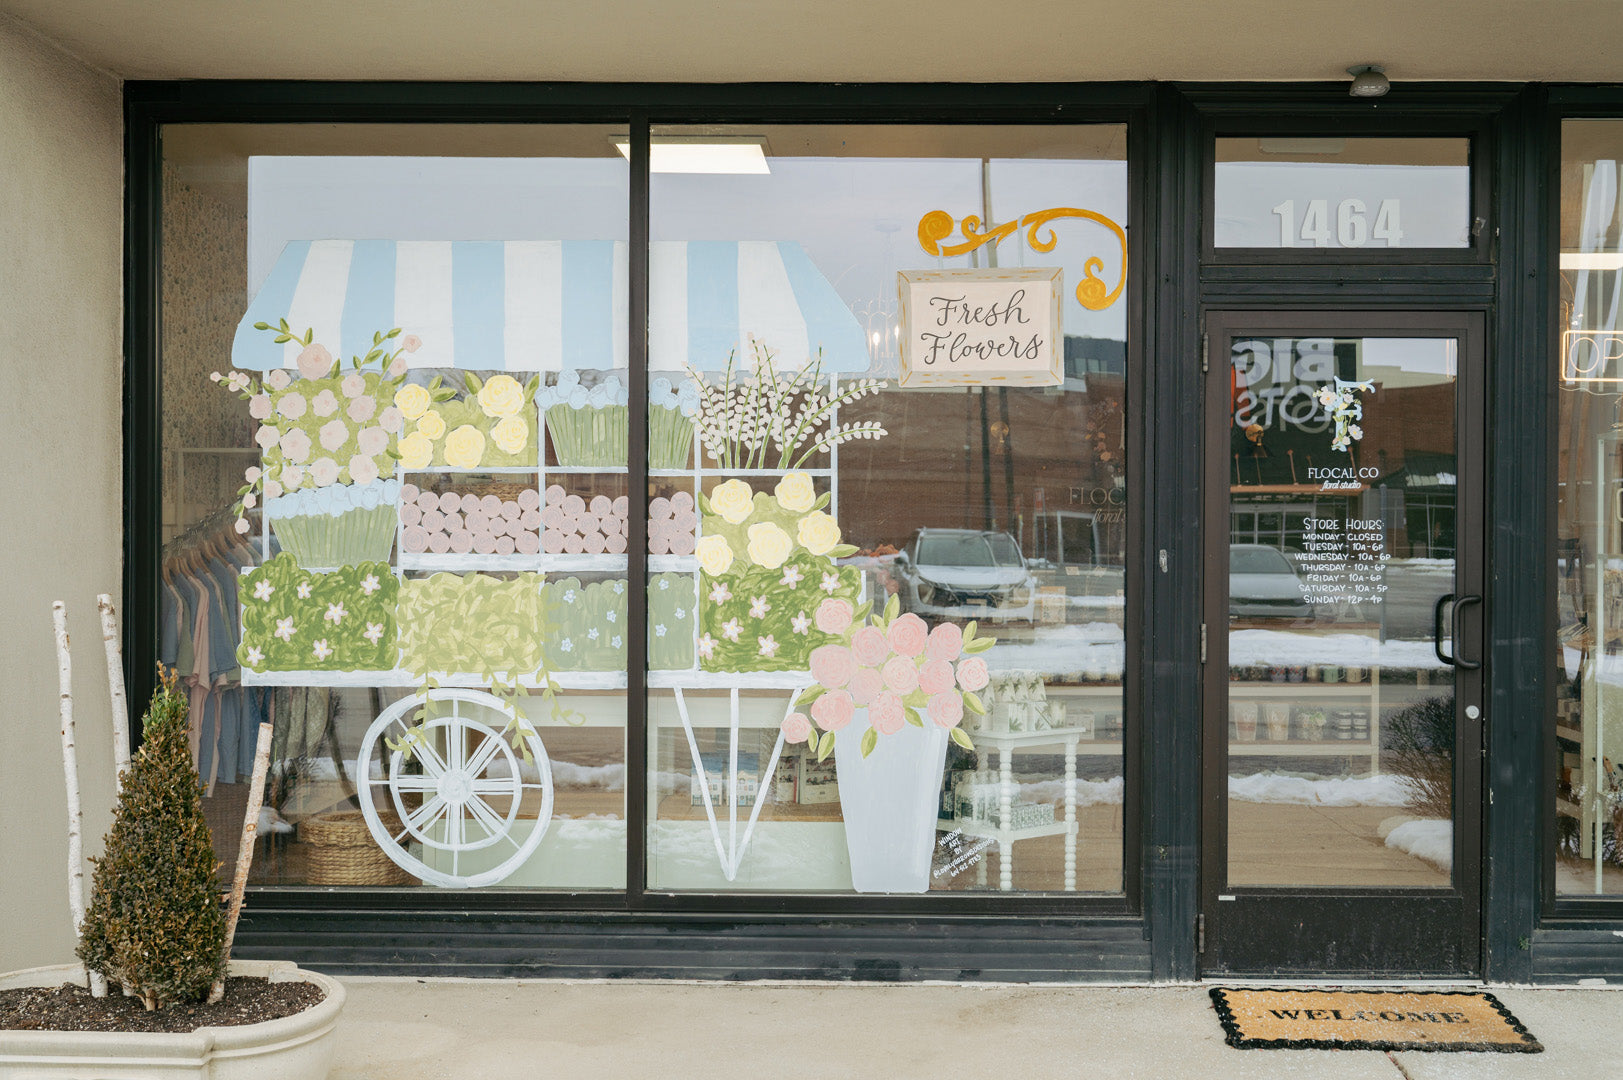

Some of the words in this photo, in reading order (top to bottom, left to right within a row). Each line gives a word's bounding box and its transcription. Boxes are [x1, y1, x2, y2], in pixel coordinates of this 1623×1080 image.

[1272, 199, 1404, 248] 1464
[929, 289, 1030, 326] Fresh
[920, 331, 1043, 365] Flowers
[1307, 467, 1357, 479] FLOCAL
[1358, 466, 1379, 478] CO
[1319, 479, 1340, 492] floral
[1340, 479, 1362, 490] studio
[1069, 487, 1125, 506] FLOC
[1303, 517, 1340, 531] STORE
[1347, 533, 1383, 541] CLOSED
[1302, 542, 1344, 551] TUESDAY
[1294, 552, 1349, 561] WEDNESDAY
[1301, 563, 1346, 571] THURSDAY
[1298, 584, 1346, 593] SATURDAY
[938, 827, 963, 847] WINDOW
[948, 838, 961, 849] ART
[953, 846, 963, 855] BY
[1268, 1009, 1470, 1024] WELCOME
